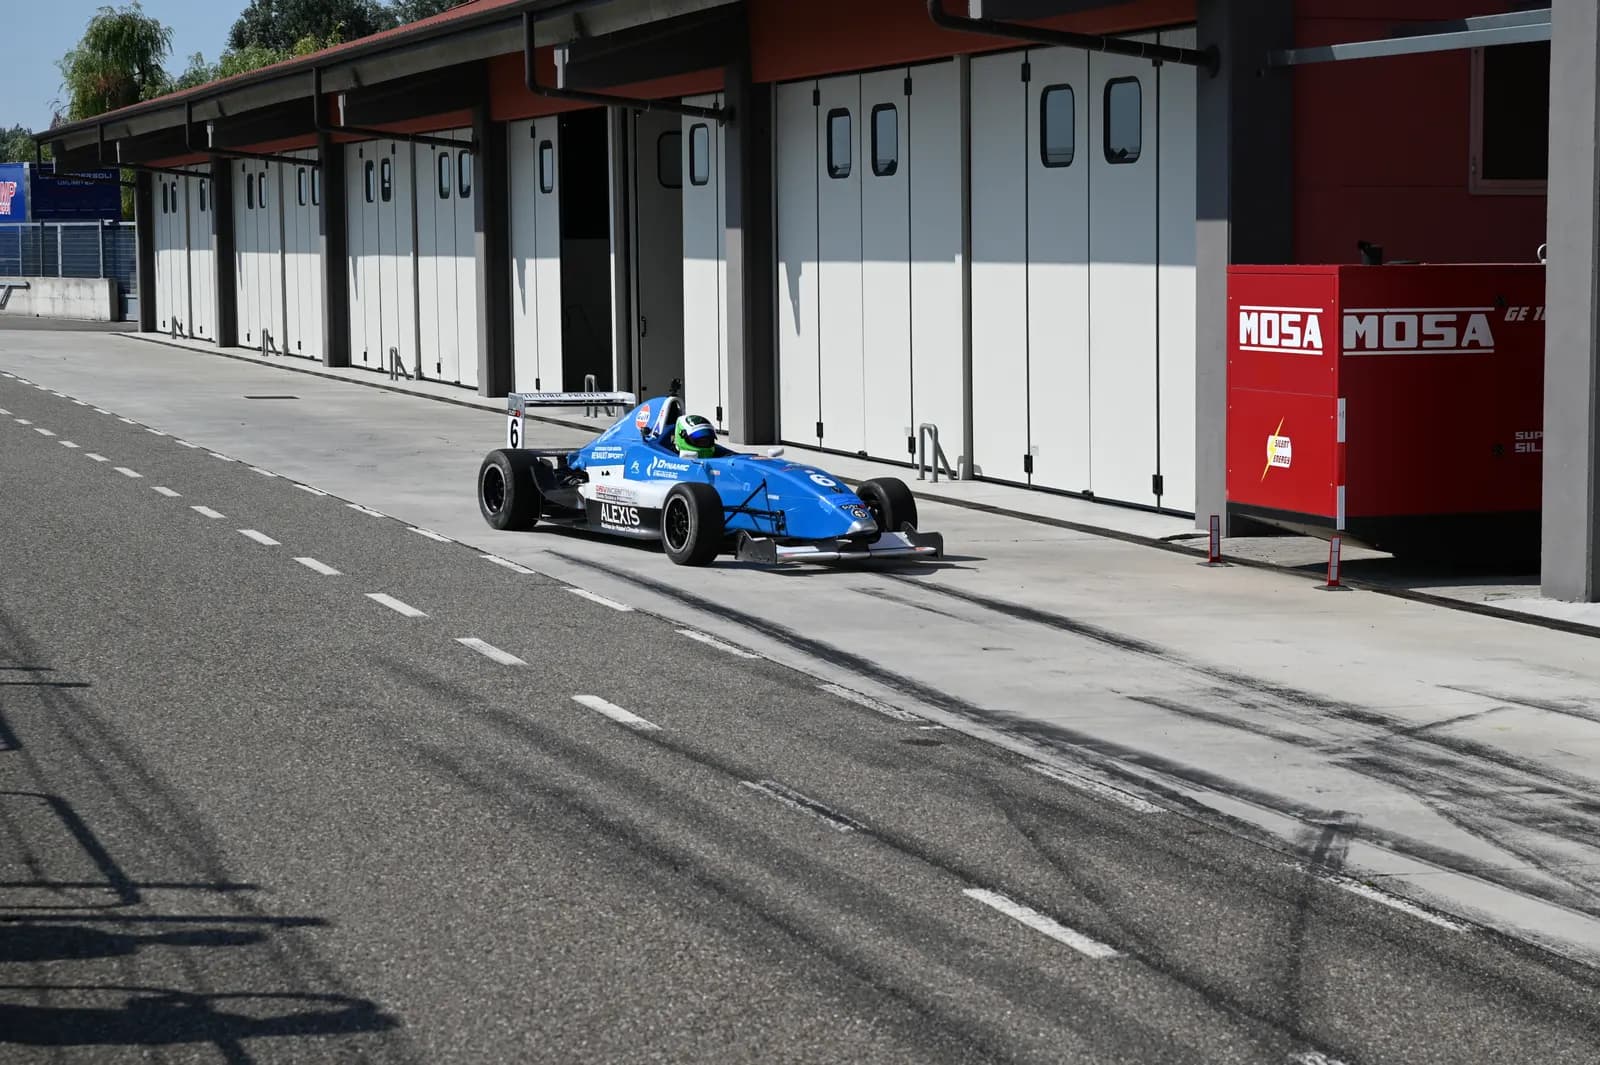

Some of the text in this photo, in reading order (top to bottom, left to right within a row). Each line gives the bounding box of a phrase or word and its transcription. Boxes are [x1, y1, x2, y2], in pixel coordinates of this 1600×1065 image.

[1504, 306, 1530, 321] GE
[1239, 312, 1323, 349] MOSA
[1342, 313, 1495, 349] MOSA
[510, 418, 519, 449] 6
[1274, 439, 1290, 448] SILENT
[1272, 454, 1291, 465] ENERGY
[810, 474, 837, 487] 6
[601, 503, 640, 526] ALEXIS
